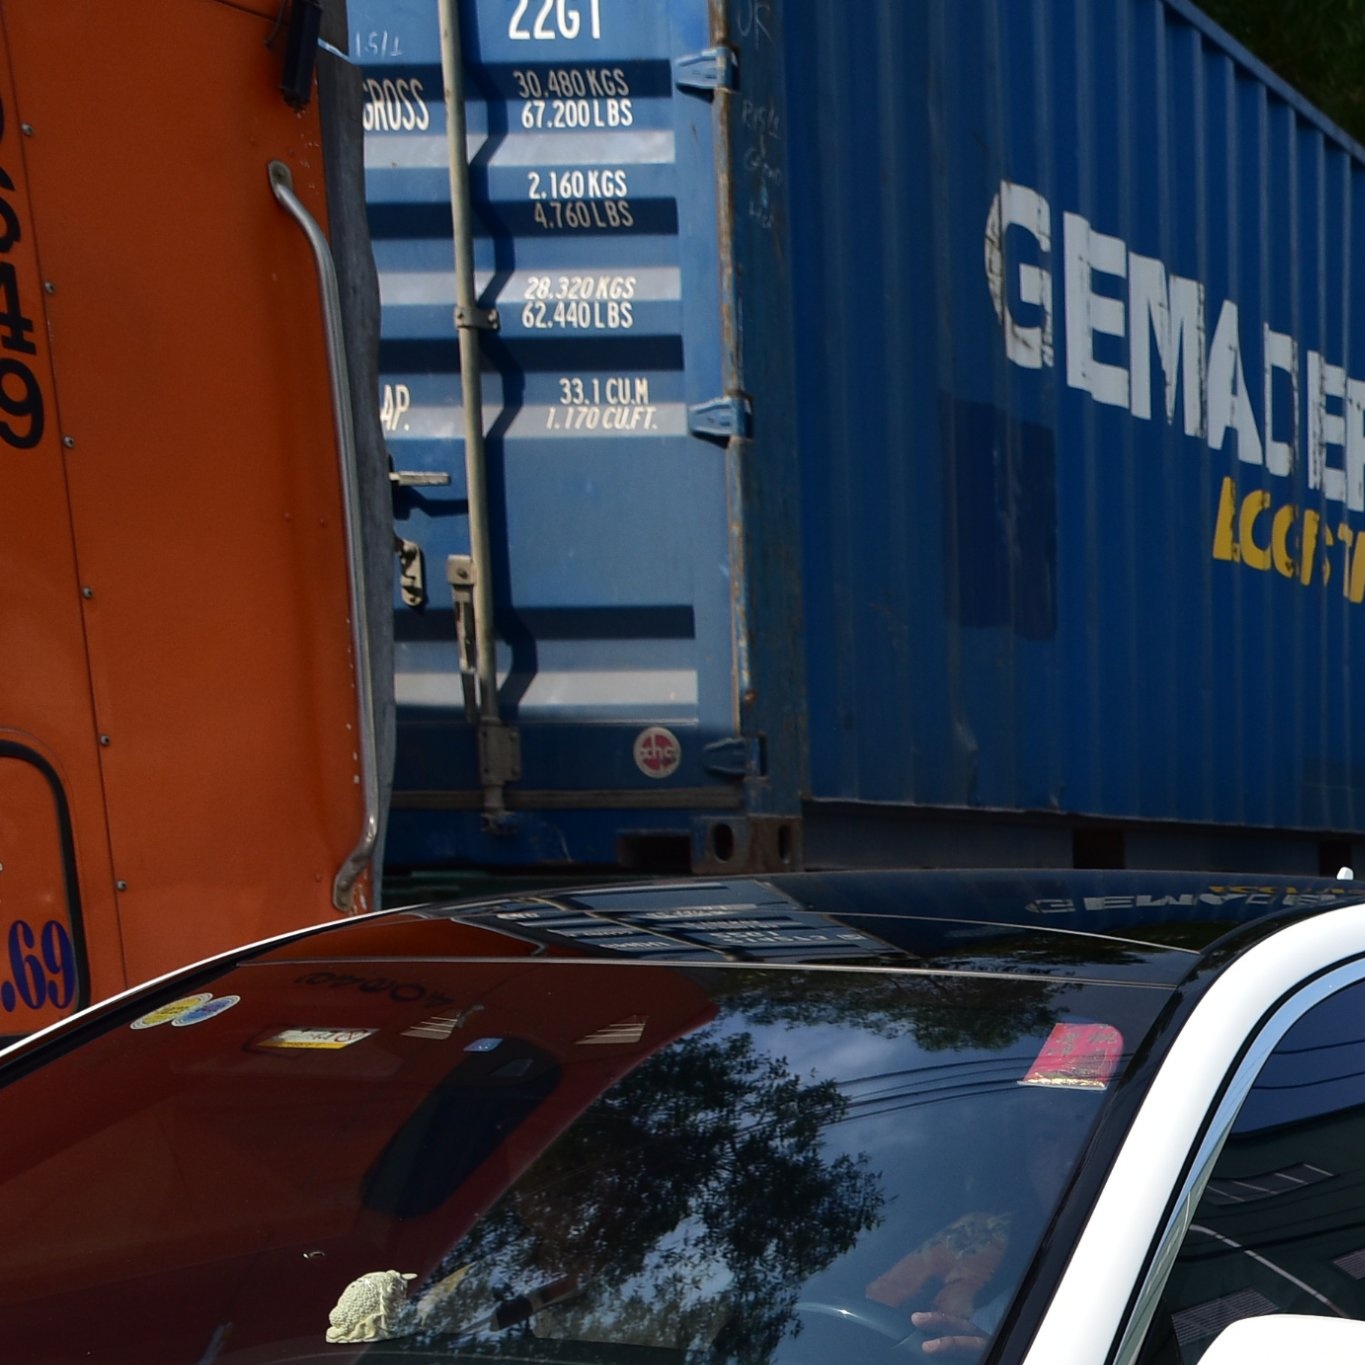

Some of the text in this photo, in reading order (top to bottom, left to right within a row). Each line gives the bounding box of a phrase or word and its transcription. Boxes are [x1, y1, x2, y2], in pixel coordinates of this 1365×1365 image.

[513, 68, 630, 98] 30.480 KGS
[521, 98, 633, 129] 67.200 LBS
[528, 169, 628, 200] 2.160 KGS
[534, 200, 634, 230] 4.760 LBS
[523, 276, 637, 300] 28.320 KGS
[521, 301, 633, 329] 62.440 LBS
[559, 378, 600, 405] 33.1
[546, 407, 599, 430] 1.170
